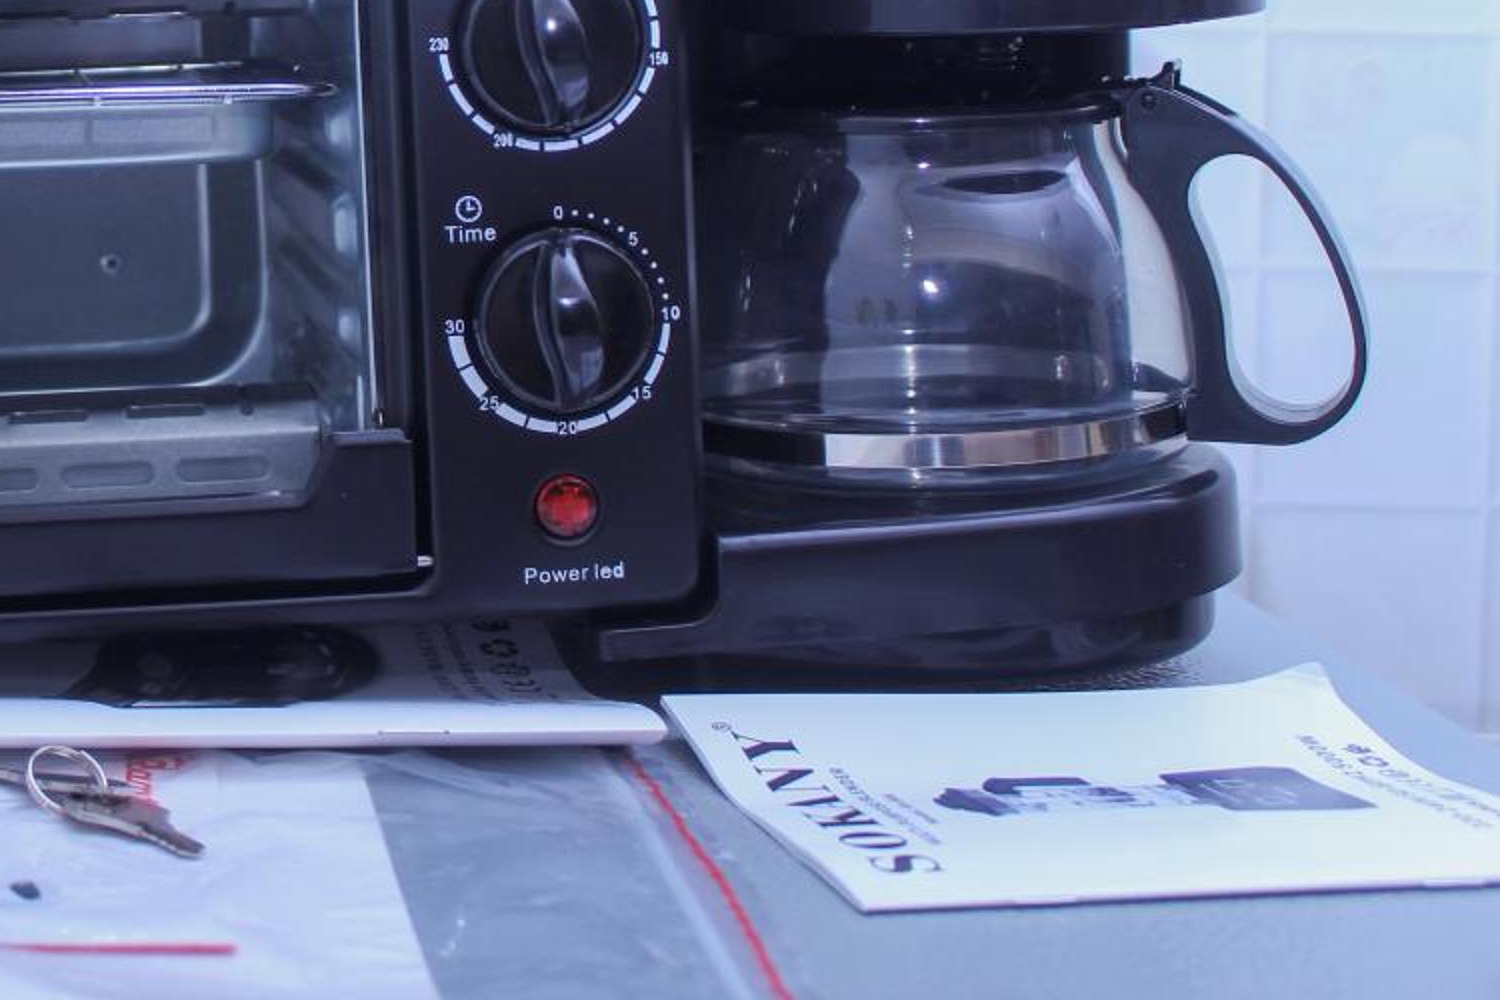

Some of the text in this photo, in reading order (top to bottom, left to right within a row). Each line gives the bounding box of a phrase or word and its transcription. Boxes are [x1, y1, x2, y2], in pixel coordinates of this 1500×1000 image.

[429, 37, 450, 53] 230
[650, 50, 669, 66] 150
[493, 134, 514, 149] 200
[553, 206, 563, 220] 0
[444, 224, 497, 244] Time
[628, 232, 638, 247] 5
[661, 306, 681, 321] 10
[445, 319, 465, 335] 30
[633, 386, 652, 400] 15
[479, 395, 500, 411] 25
[557, 421, 578, 436] 20
[524, 561, 626, 586] Power led
